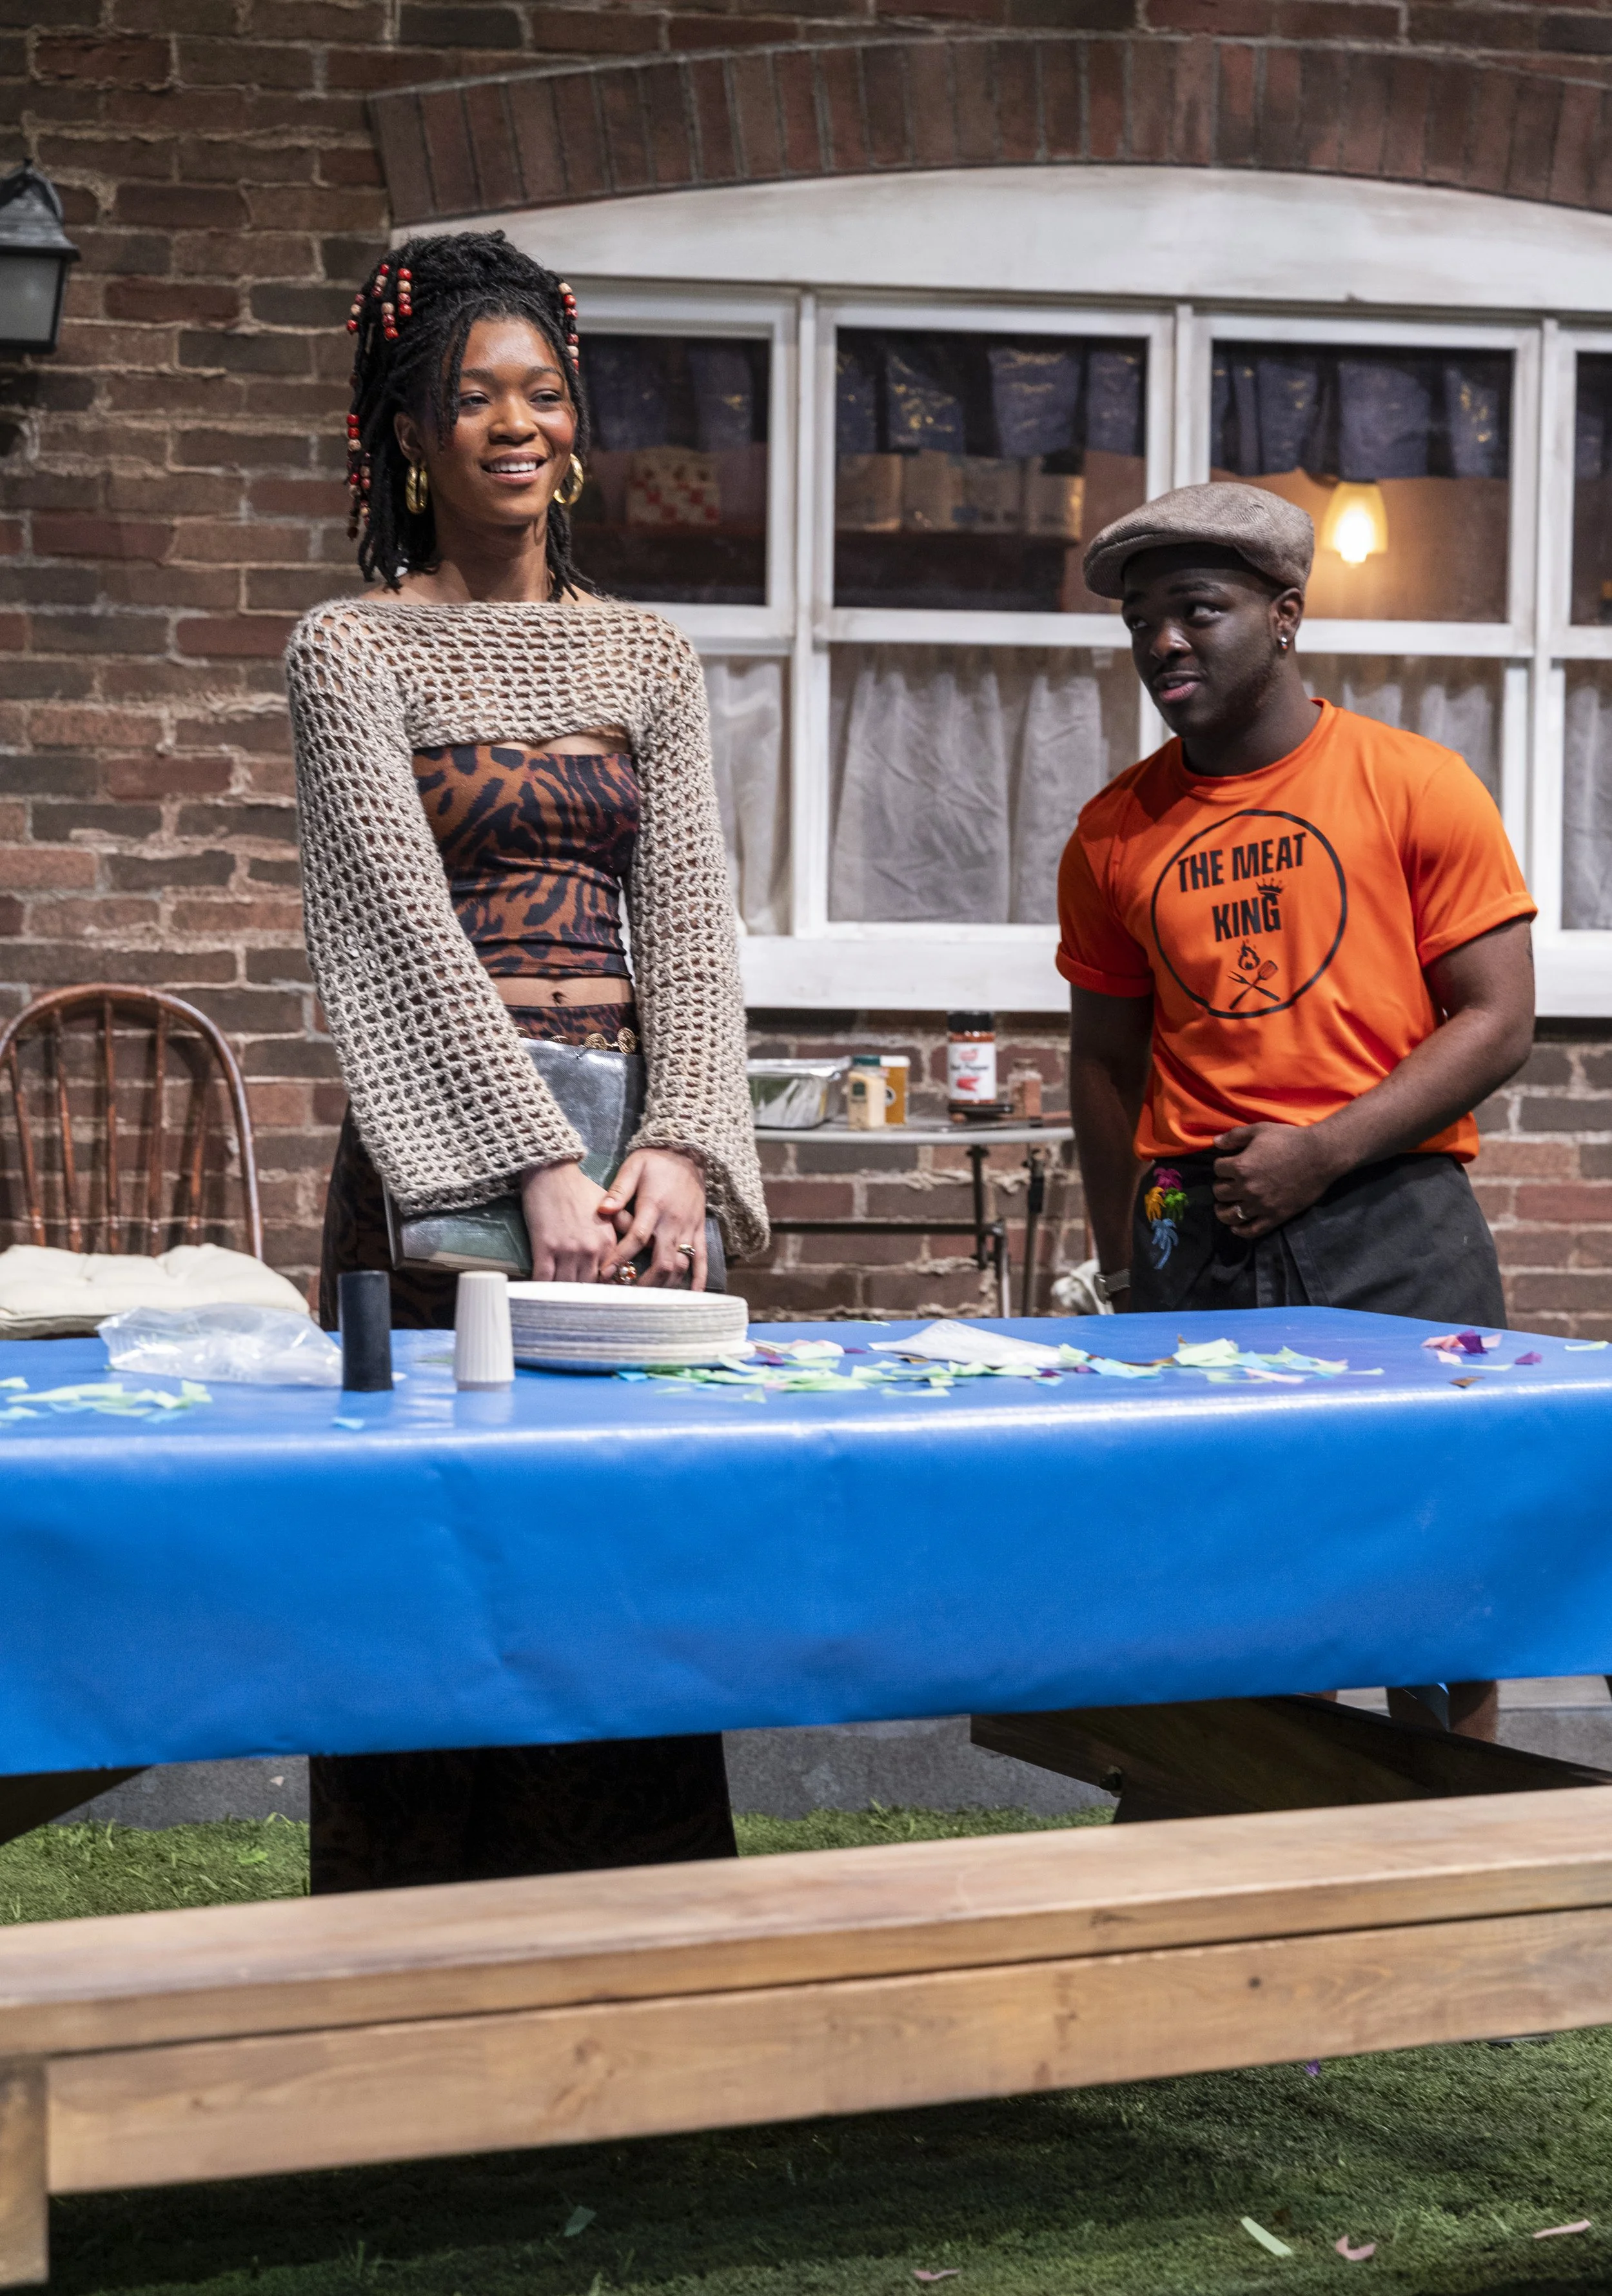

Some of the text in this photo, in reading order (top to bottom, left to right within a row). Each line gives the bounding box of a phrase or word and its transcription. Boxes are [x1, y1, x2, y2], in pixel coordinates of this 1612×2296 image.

[1177, 832, 1307, 893] THE MEAT
[1212, 895, 1282, 942] KING
